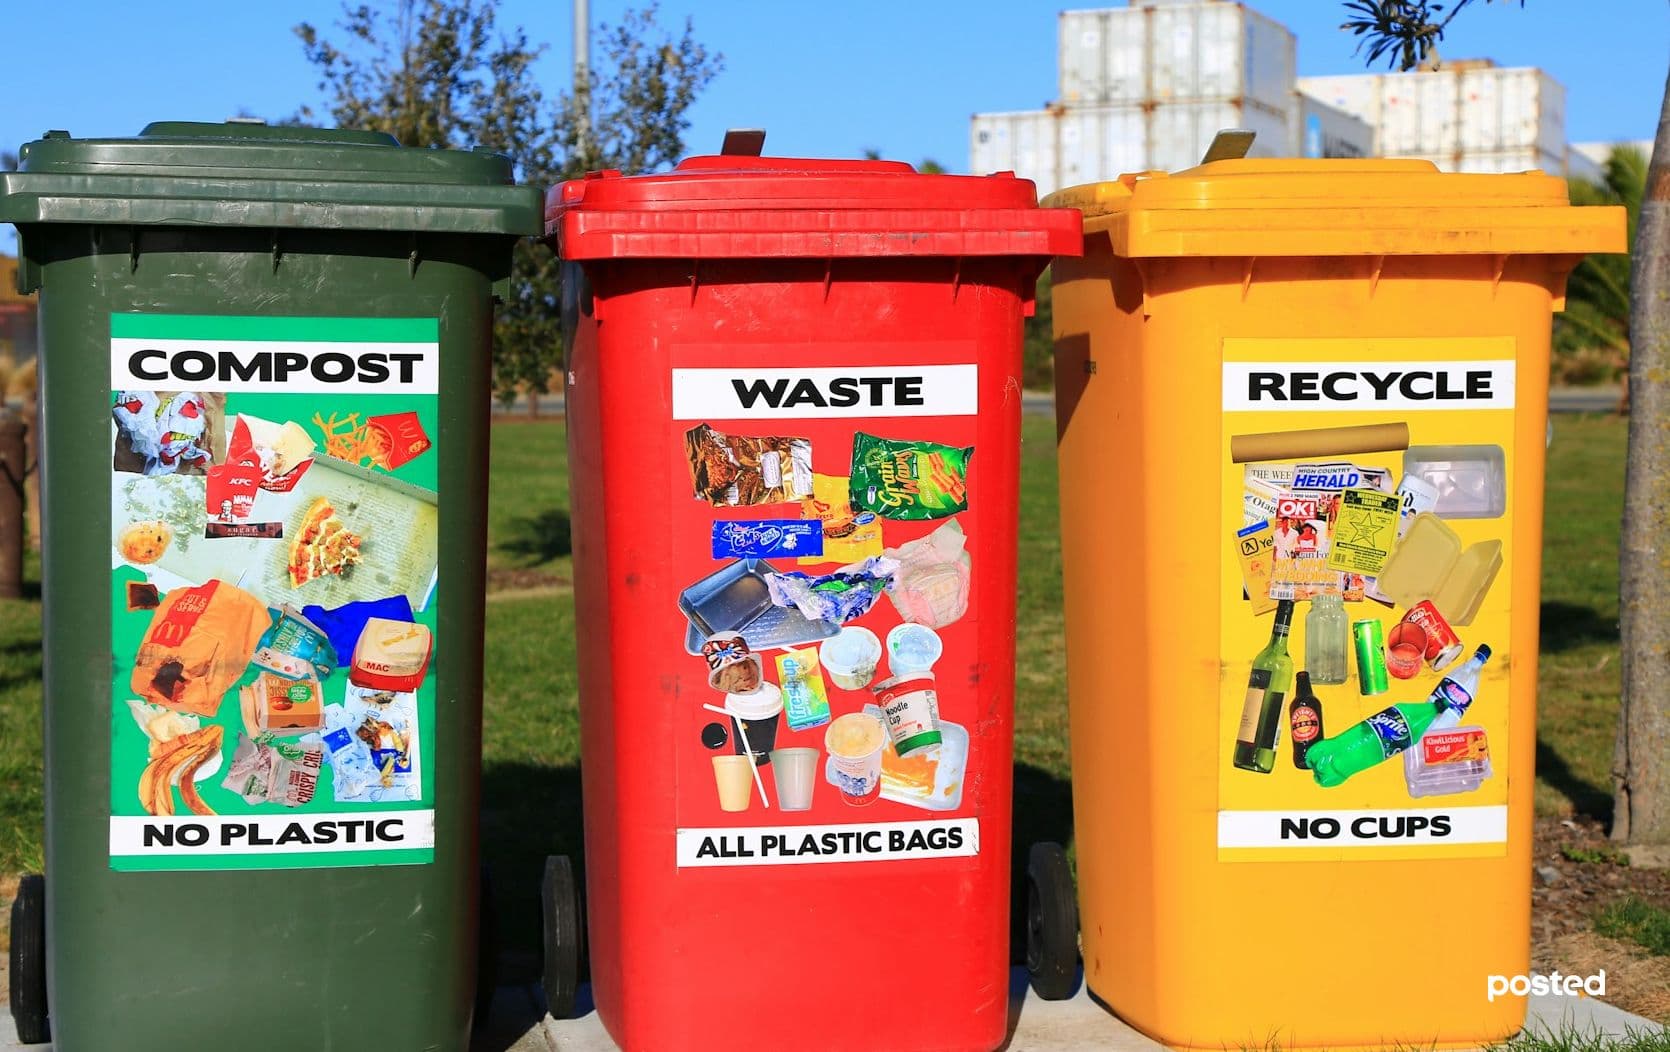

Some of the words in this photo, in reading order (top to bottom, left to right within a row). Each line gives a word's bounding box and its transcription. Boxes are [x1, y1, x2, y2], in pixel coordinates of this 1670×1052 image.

[128, 349, 424, 384] COMPOST
[731, 376, 924, 409] WASTE
[1248, 370, 1493, 402] RECYCLE
[228, 477, 253, 487] KFC
[1251, 469, 1270, 480] THE
[1293, 473, 1359, 488] HERALD
[1253, 496, 1276, 514] Otag
[1279, 501, 1314, 516] OK!
[1260, 536, 1275, 548] Yel
[366, 662, 390, 673] MAC
[885, 701, 909, 716] Noodle
[888, 715, 901, 726] Cup
[1370, 712, 1409, 736] Sprite
[1434, 745, 1451, 753] Gold
[297, 771, 316, 804] CRISPY
[143, 823, 210, 847] NO
[220, 819, 404, 846] PLASTIC
[1280, 817, 1341, 840] NO
[1350, 815, 1452, 839] CUPS
[696, 836, 753, 859] ALL
[761, 831, 882, 856] PLASTIC
[888, 827, 964, 851] BAGS
